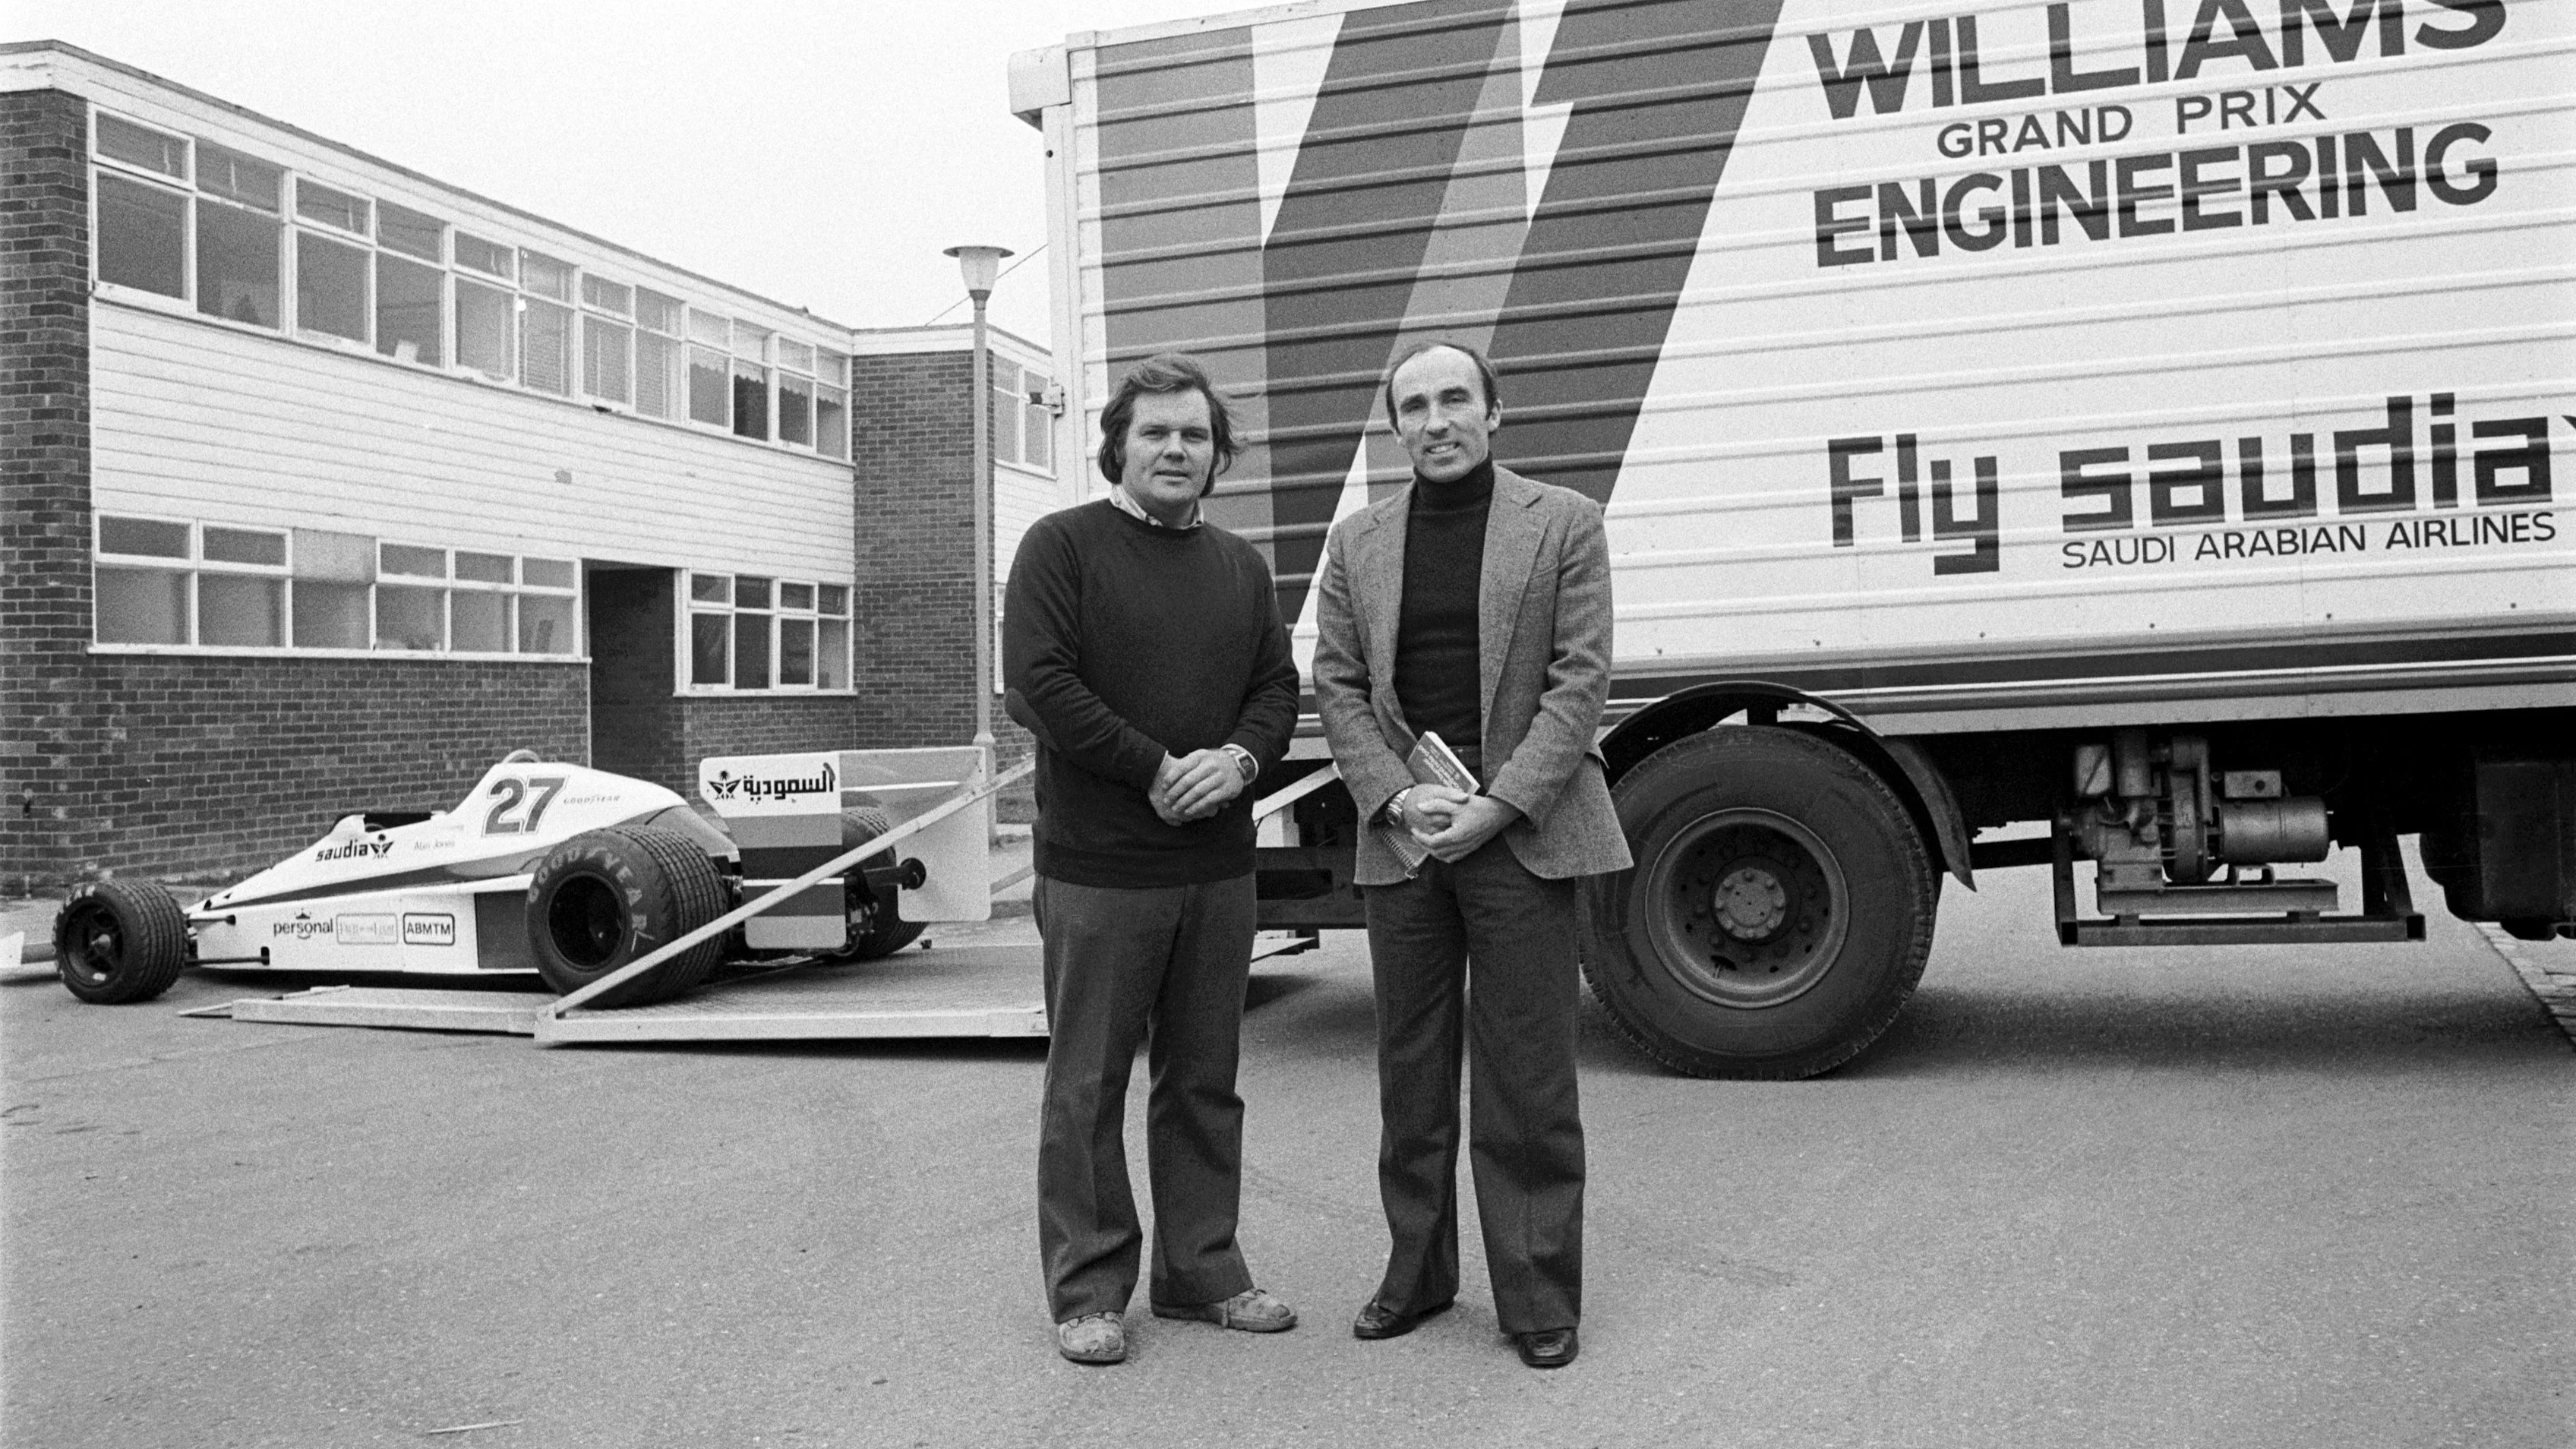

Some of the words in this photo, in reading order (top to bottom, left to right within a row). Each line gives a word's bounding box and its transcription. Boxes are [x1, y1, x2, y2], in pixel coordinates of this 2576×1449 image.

[1806, 0, 2507, 120] WILLIAMS
[1937, 106, 2132, 158] GRAND
[2177, 83, 2326, 134] PRIX
[1814, 122, 2499, 267] ENGINEERING
[1829, 434, 2000, 576] Fly
[2060, 393, 2553, 532] saudia
[2062, 535, 2176, 568] SAUDI
[2195, 525, 2366, 560] ARABIAN
[2385, 511, 2556, 552] AIRLINES
[483, 775, 567, 836] 27
[315, 838, 368, 863] saudia
[273, 917, 333, 937] personal
[406, 922, 451, 936] ABMTM
